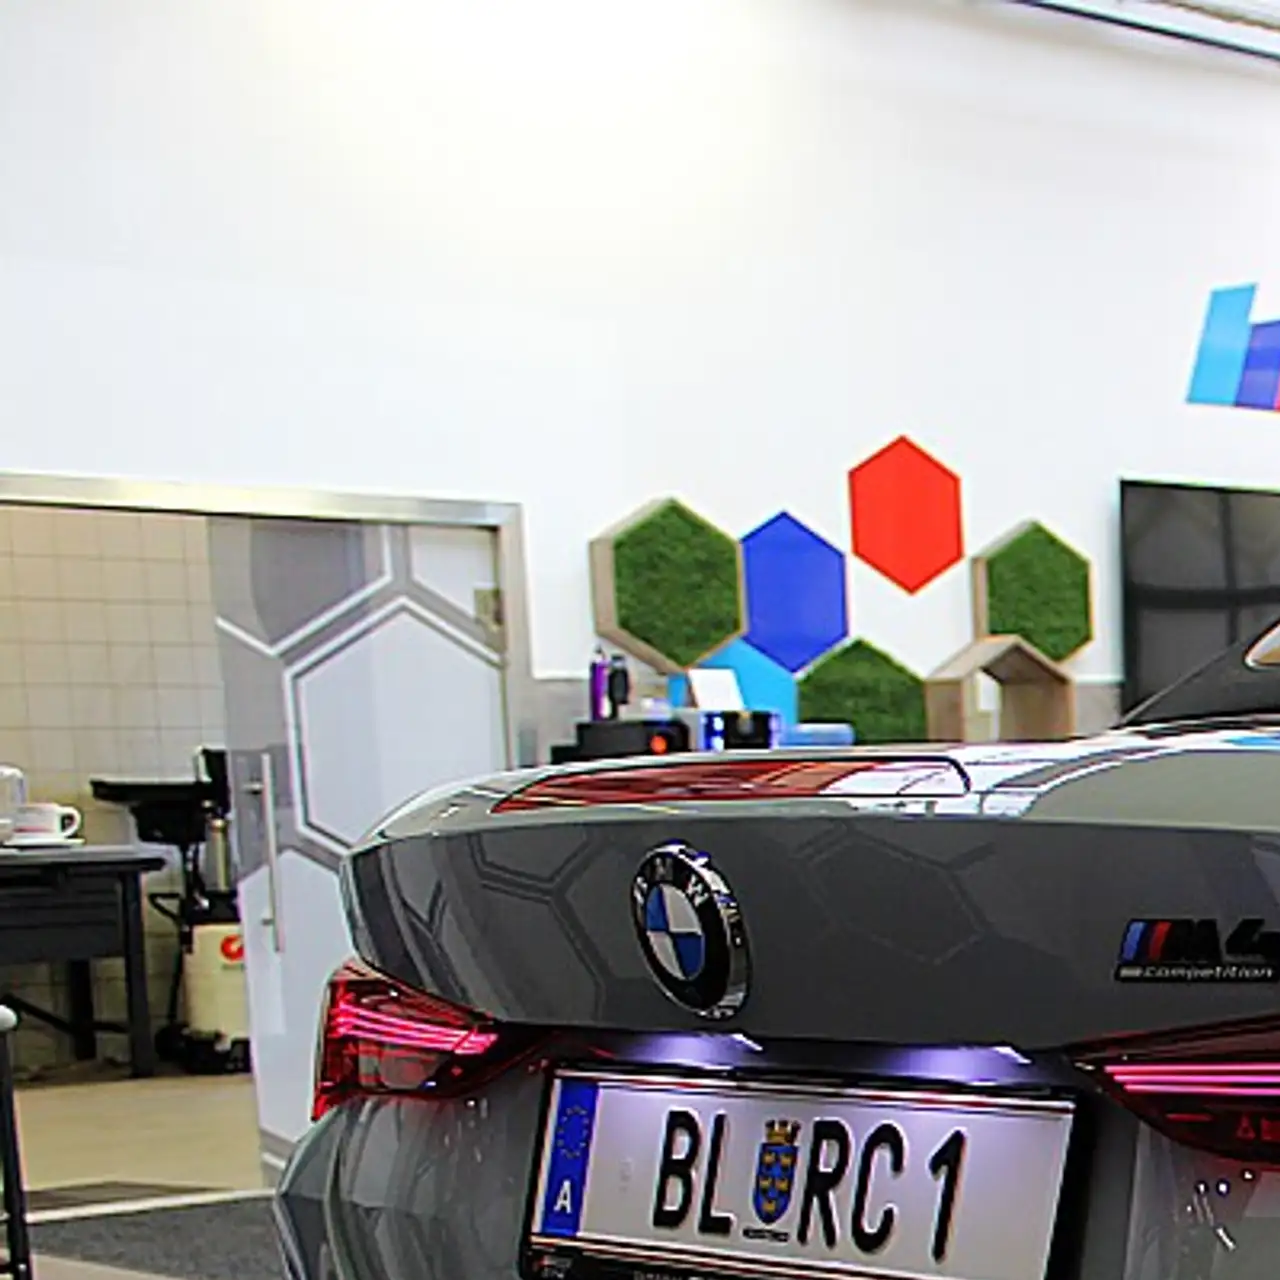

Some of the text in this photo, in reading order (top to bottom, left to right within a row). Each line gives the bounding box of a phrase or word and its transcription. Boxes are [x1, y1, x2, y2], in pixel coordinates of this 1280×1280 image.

[553, 1181, 573, 1214] A
[652, 1109, 967, 1263] BL RC 1
